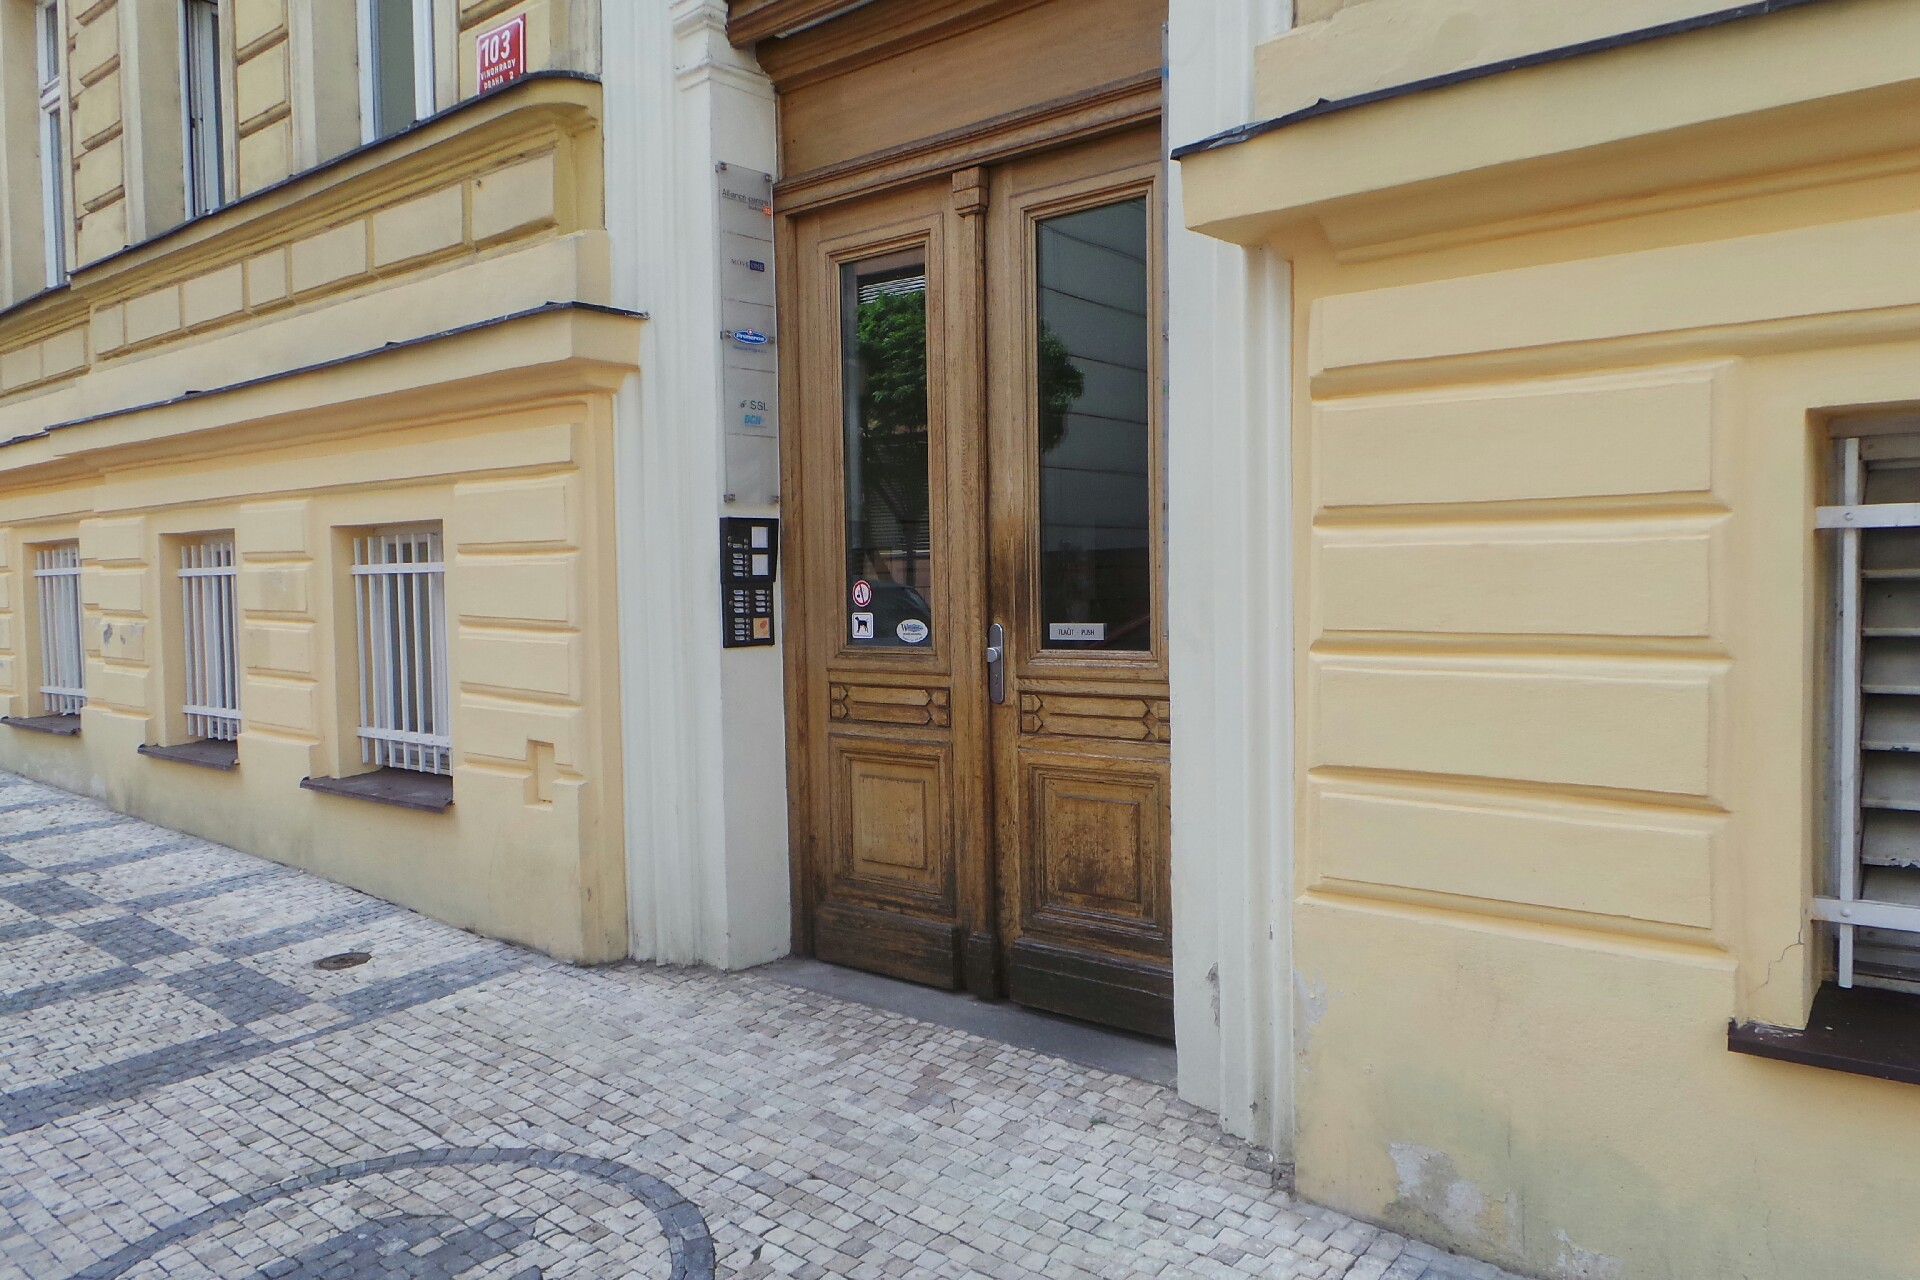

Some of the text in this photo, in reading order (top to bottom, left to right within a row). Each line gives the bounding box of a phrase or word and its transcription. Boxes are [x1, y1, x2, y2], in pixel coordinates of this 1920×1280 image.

[481, 29, 511, 68] 103
[480, 58, 516, 81] VINOHRADY
[483, 71, 514, 91] PRAHA 2
[750, 400, 769, 412] SSL
[1058, 628, 1074, 636] TLAČIT
